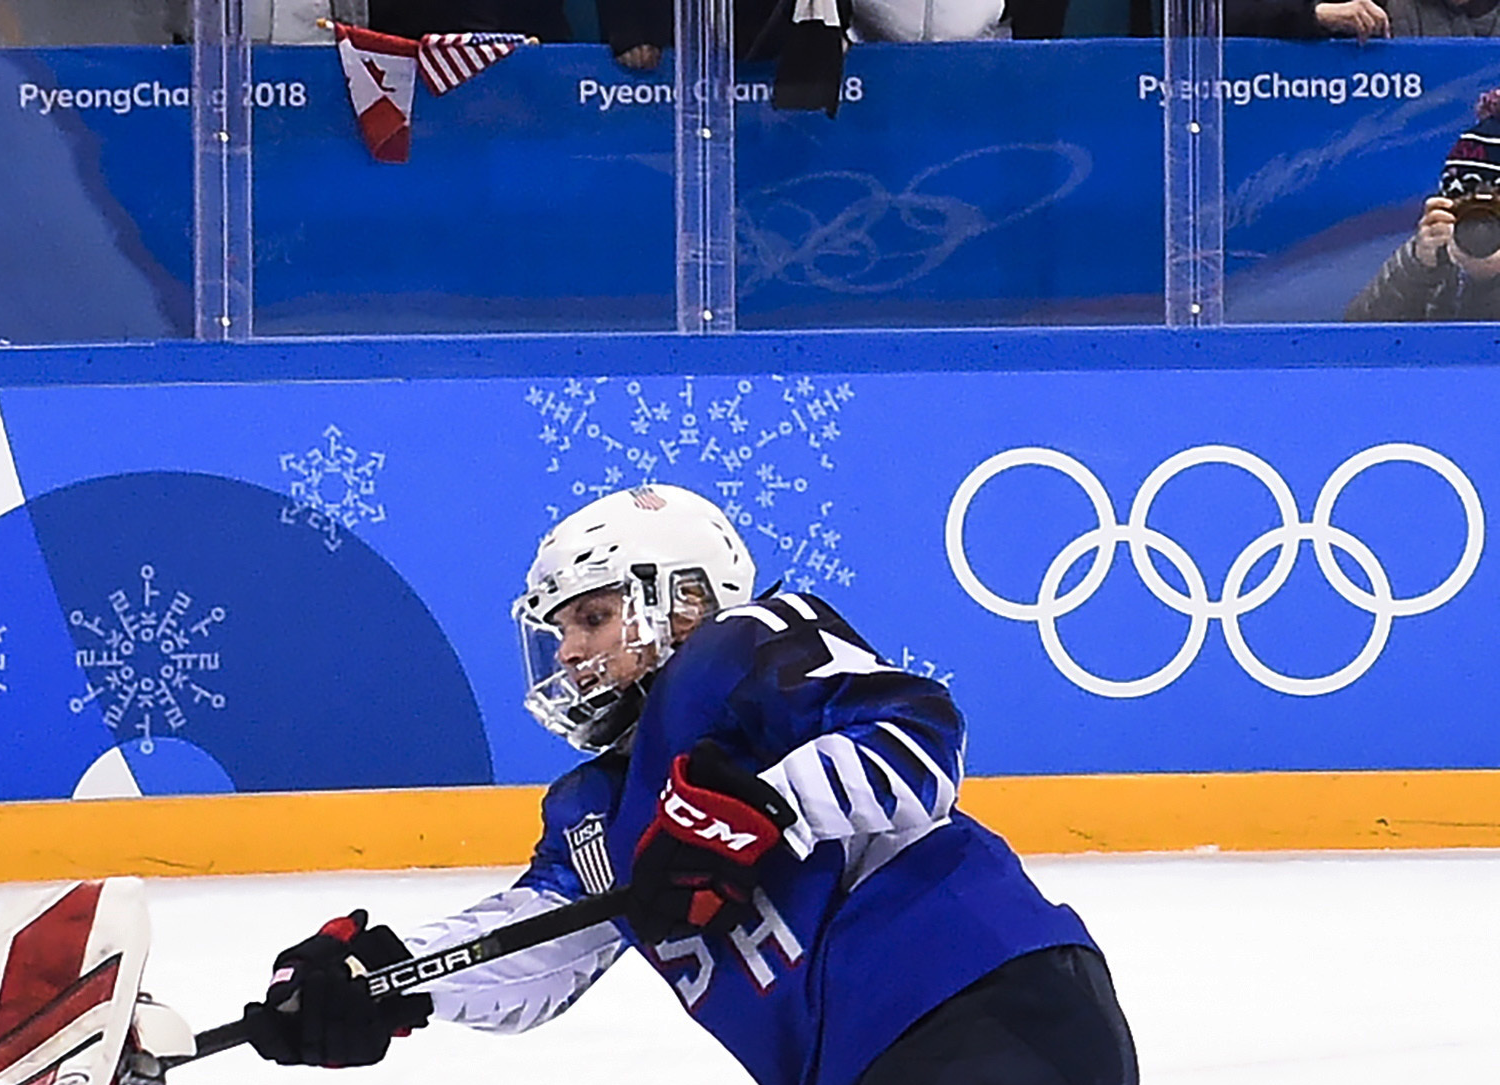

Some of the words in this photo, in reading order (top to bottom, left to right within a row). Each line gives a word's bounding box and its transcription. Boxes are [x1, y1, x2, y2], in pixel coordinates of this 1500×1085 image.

[19, 81, 225, 114] PyeongChag
[1352, 73, 1422, 98] 2018
[573, 820, 604, 846] USA
